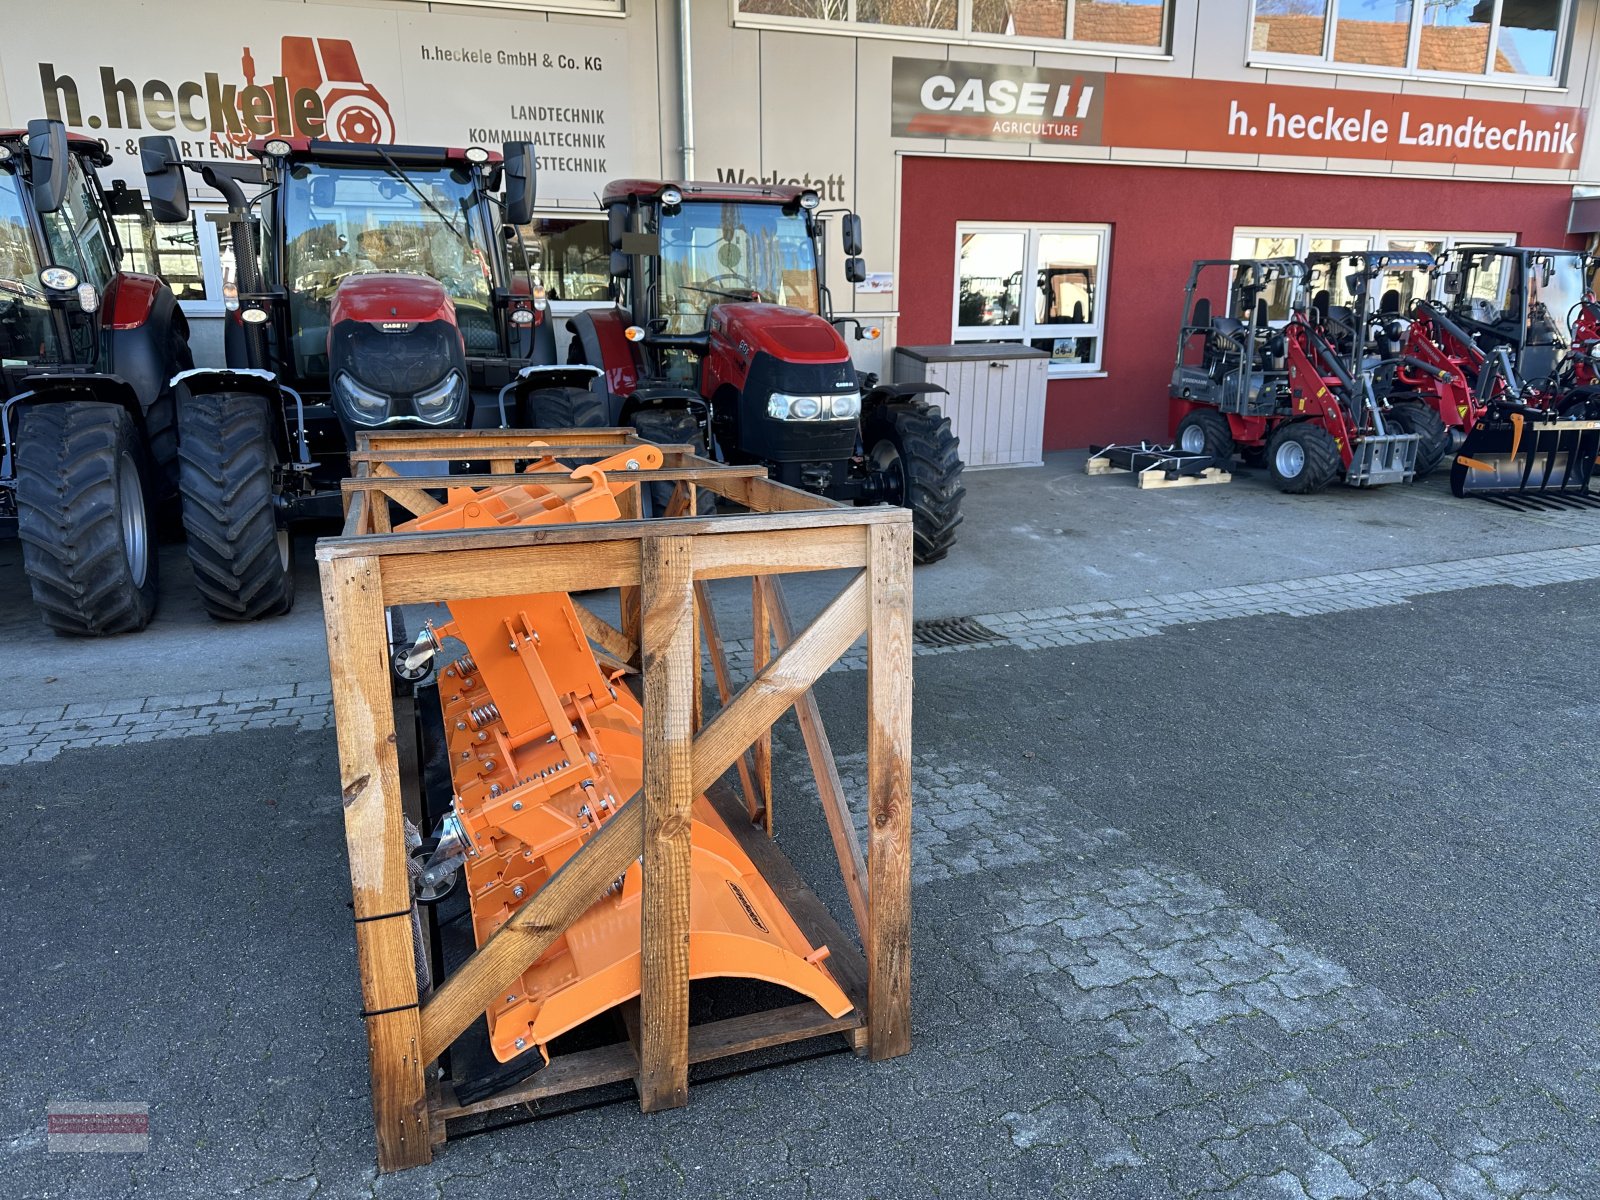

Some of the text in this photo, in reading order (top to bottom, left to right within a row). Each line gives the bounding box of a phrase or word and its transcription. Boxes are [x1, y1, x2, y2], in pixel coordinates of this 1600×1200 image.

[421, 45, 603, 71] h.heckele GmbH & Co. KG
[38, 63, 325, 137] h.heckele
[920, 75, 1050, 116] CASE
[510, 105, 605, 124] LANDTECHNIK
[992, 121, 1079, 137] AGRICULTURE
[1228, 100, 1578, 154] h. heckele Landtechnik
[125, 138, 138, 156] &
[535, 156, 607, 173] STTECHNIK
